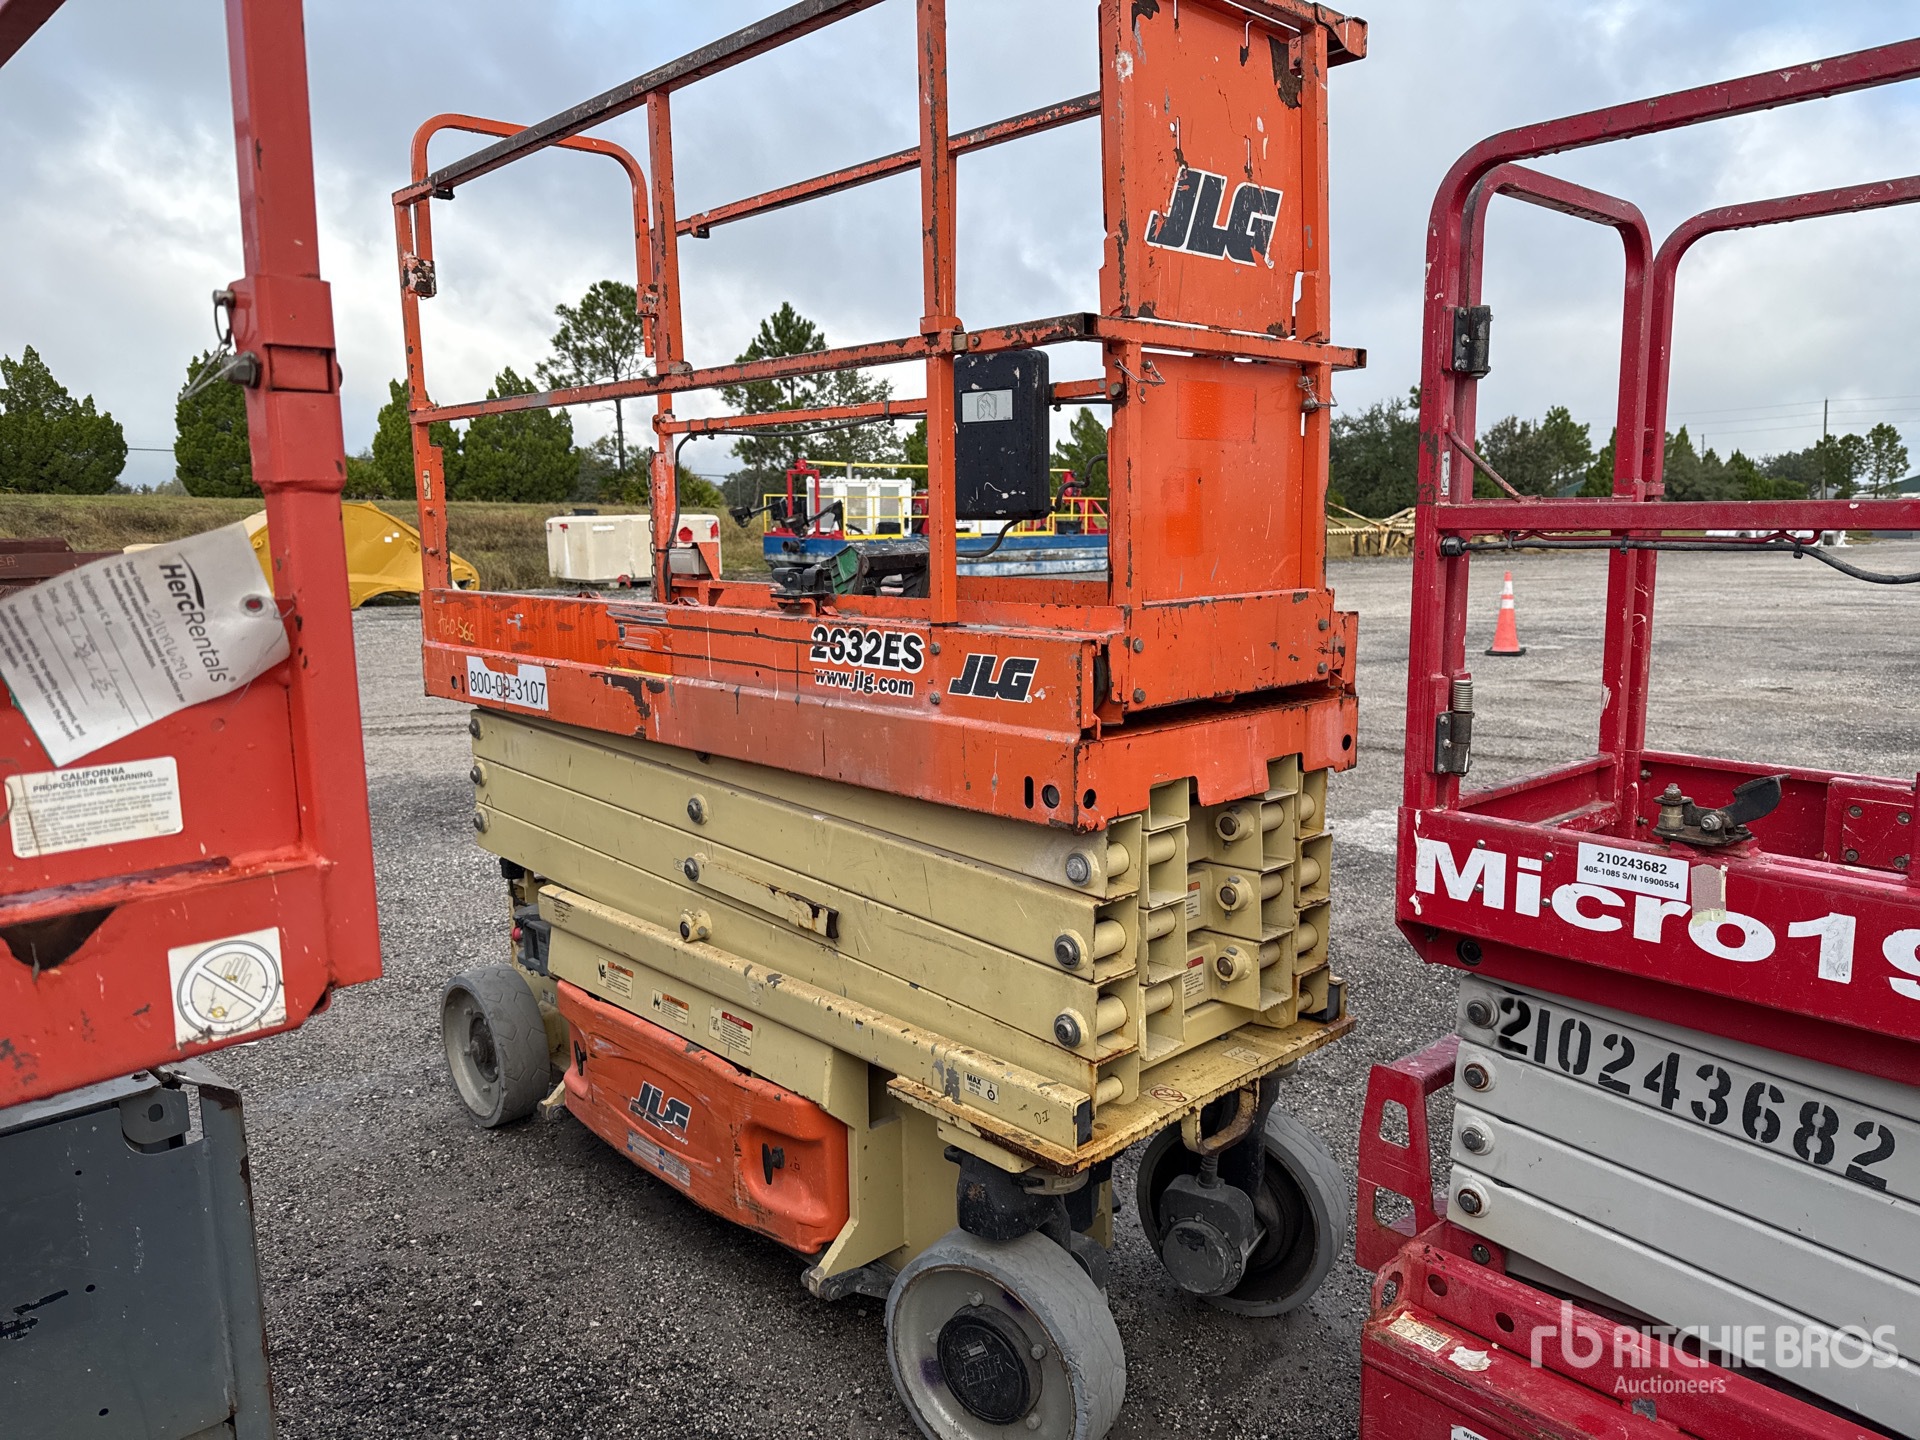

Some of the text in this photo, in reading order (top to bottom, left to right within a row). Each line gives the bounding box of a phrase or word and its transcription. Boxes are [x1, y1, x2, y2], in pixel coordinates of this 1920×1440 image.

[1145, 166, 1283, 267] JLG
[811, 625, 925, 672] 2632ES
[814, 668, 914, 697] www.jlg.com
[949, 654, 1039, 702] JLG
[33, 777, 96, 793] PROPOSITION
[111, 769, 153, 783] WARNING
[60, 765, 125, 782] CALIFORNIA
[1584, 864, 1680, 891] 405-1085 S/N 16900554
[1596, 851, 1668, 875] 210243682
[966, 1074, 982, 1086] MAX
[1499, 996, 1897, 1191] 210243682
[629, 1080, 692, 1134] JLG
